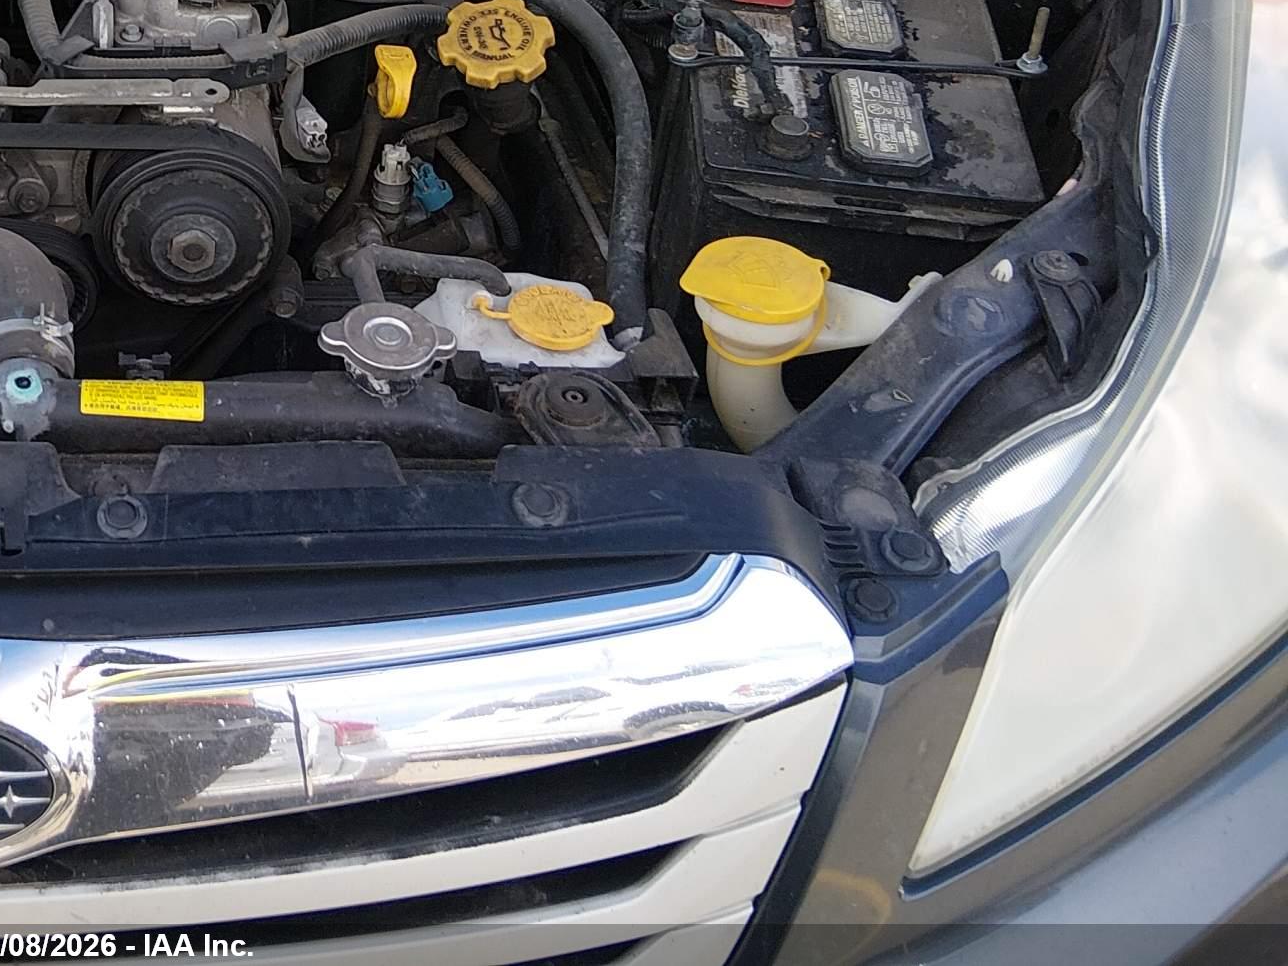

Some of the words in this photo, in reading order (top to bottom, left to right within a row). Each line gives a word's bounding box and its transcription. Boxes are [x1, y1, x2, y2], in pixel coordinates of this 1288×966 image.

[504, 10, 532, 36] ENGINE
[516, 38, 530, 51] OIL
[472, 50, 514, 61] MANUAL
